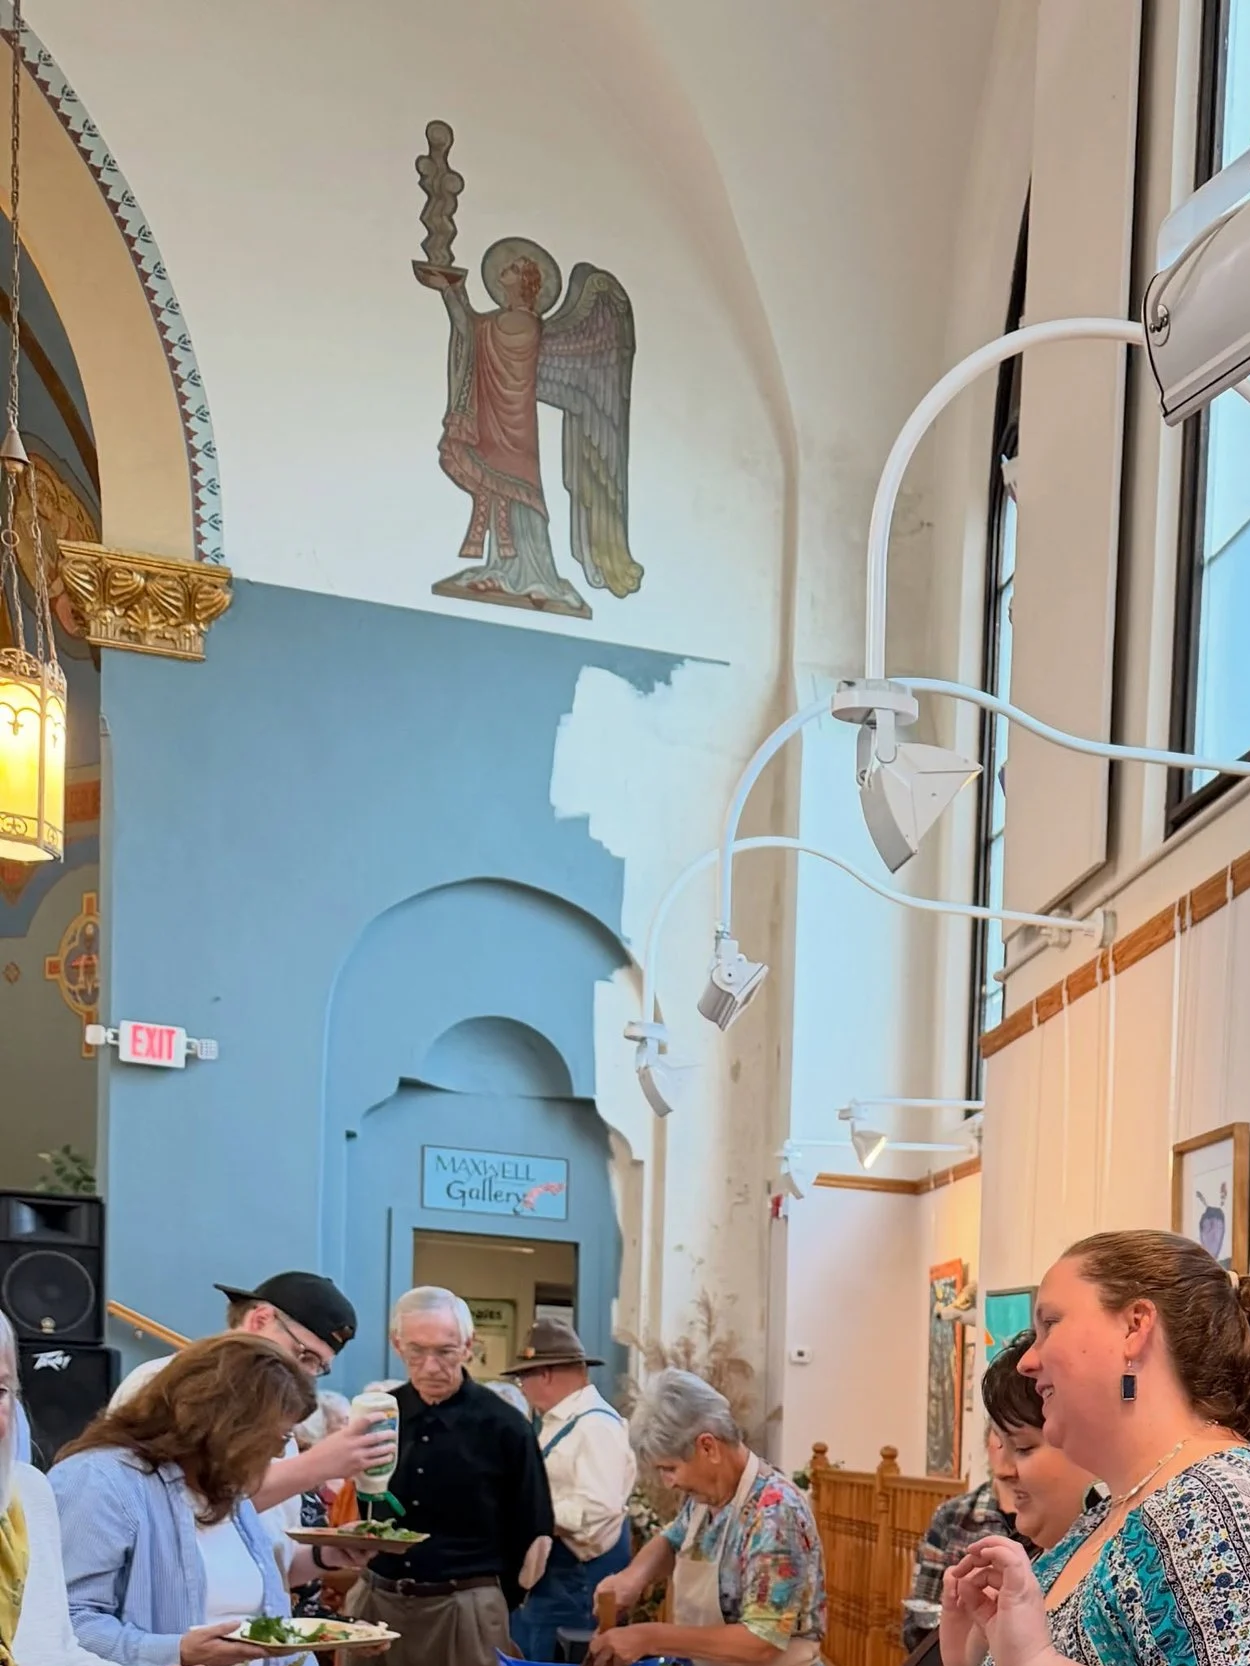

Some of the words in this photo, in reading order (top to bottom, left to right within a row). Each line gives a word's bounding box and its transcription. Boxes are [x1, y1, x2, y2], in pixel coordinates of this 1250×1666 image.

[130, 1024, 176, 1061] EXIT
[435, 1154, 536, 1183] MAXWELL
[446, 1175, 527, 1216] Gallery
